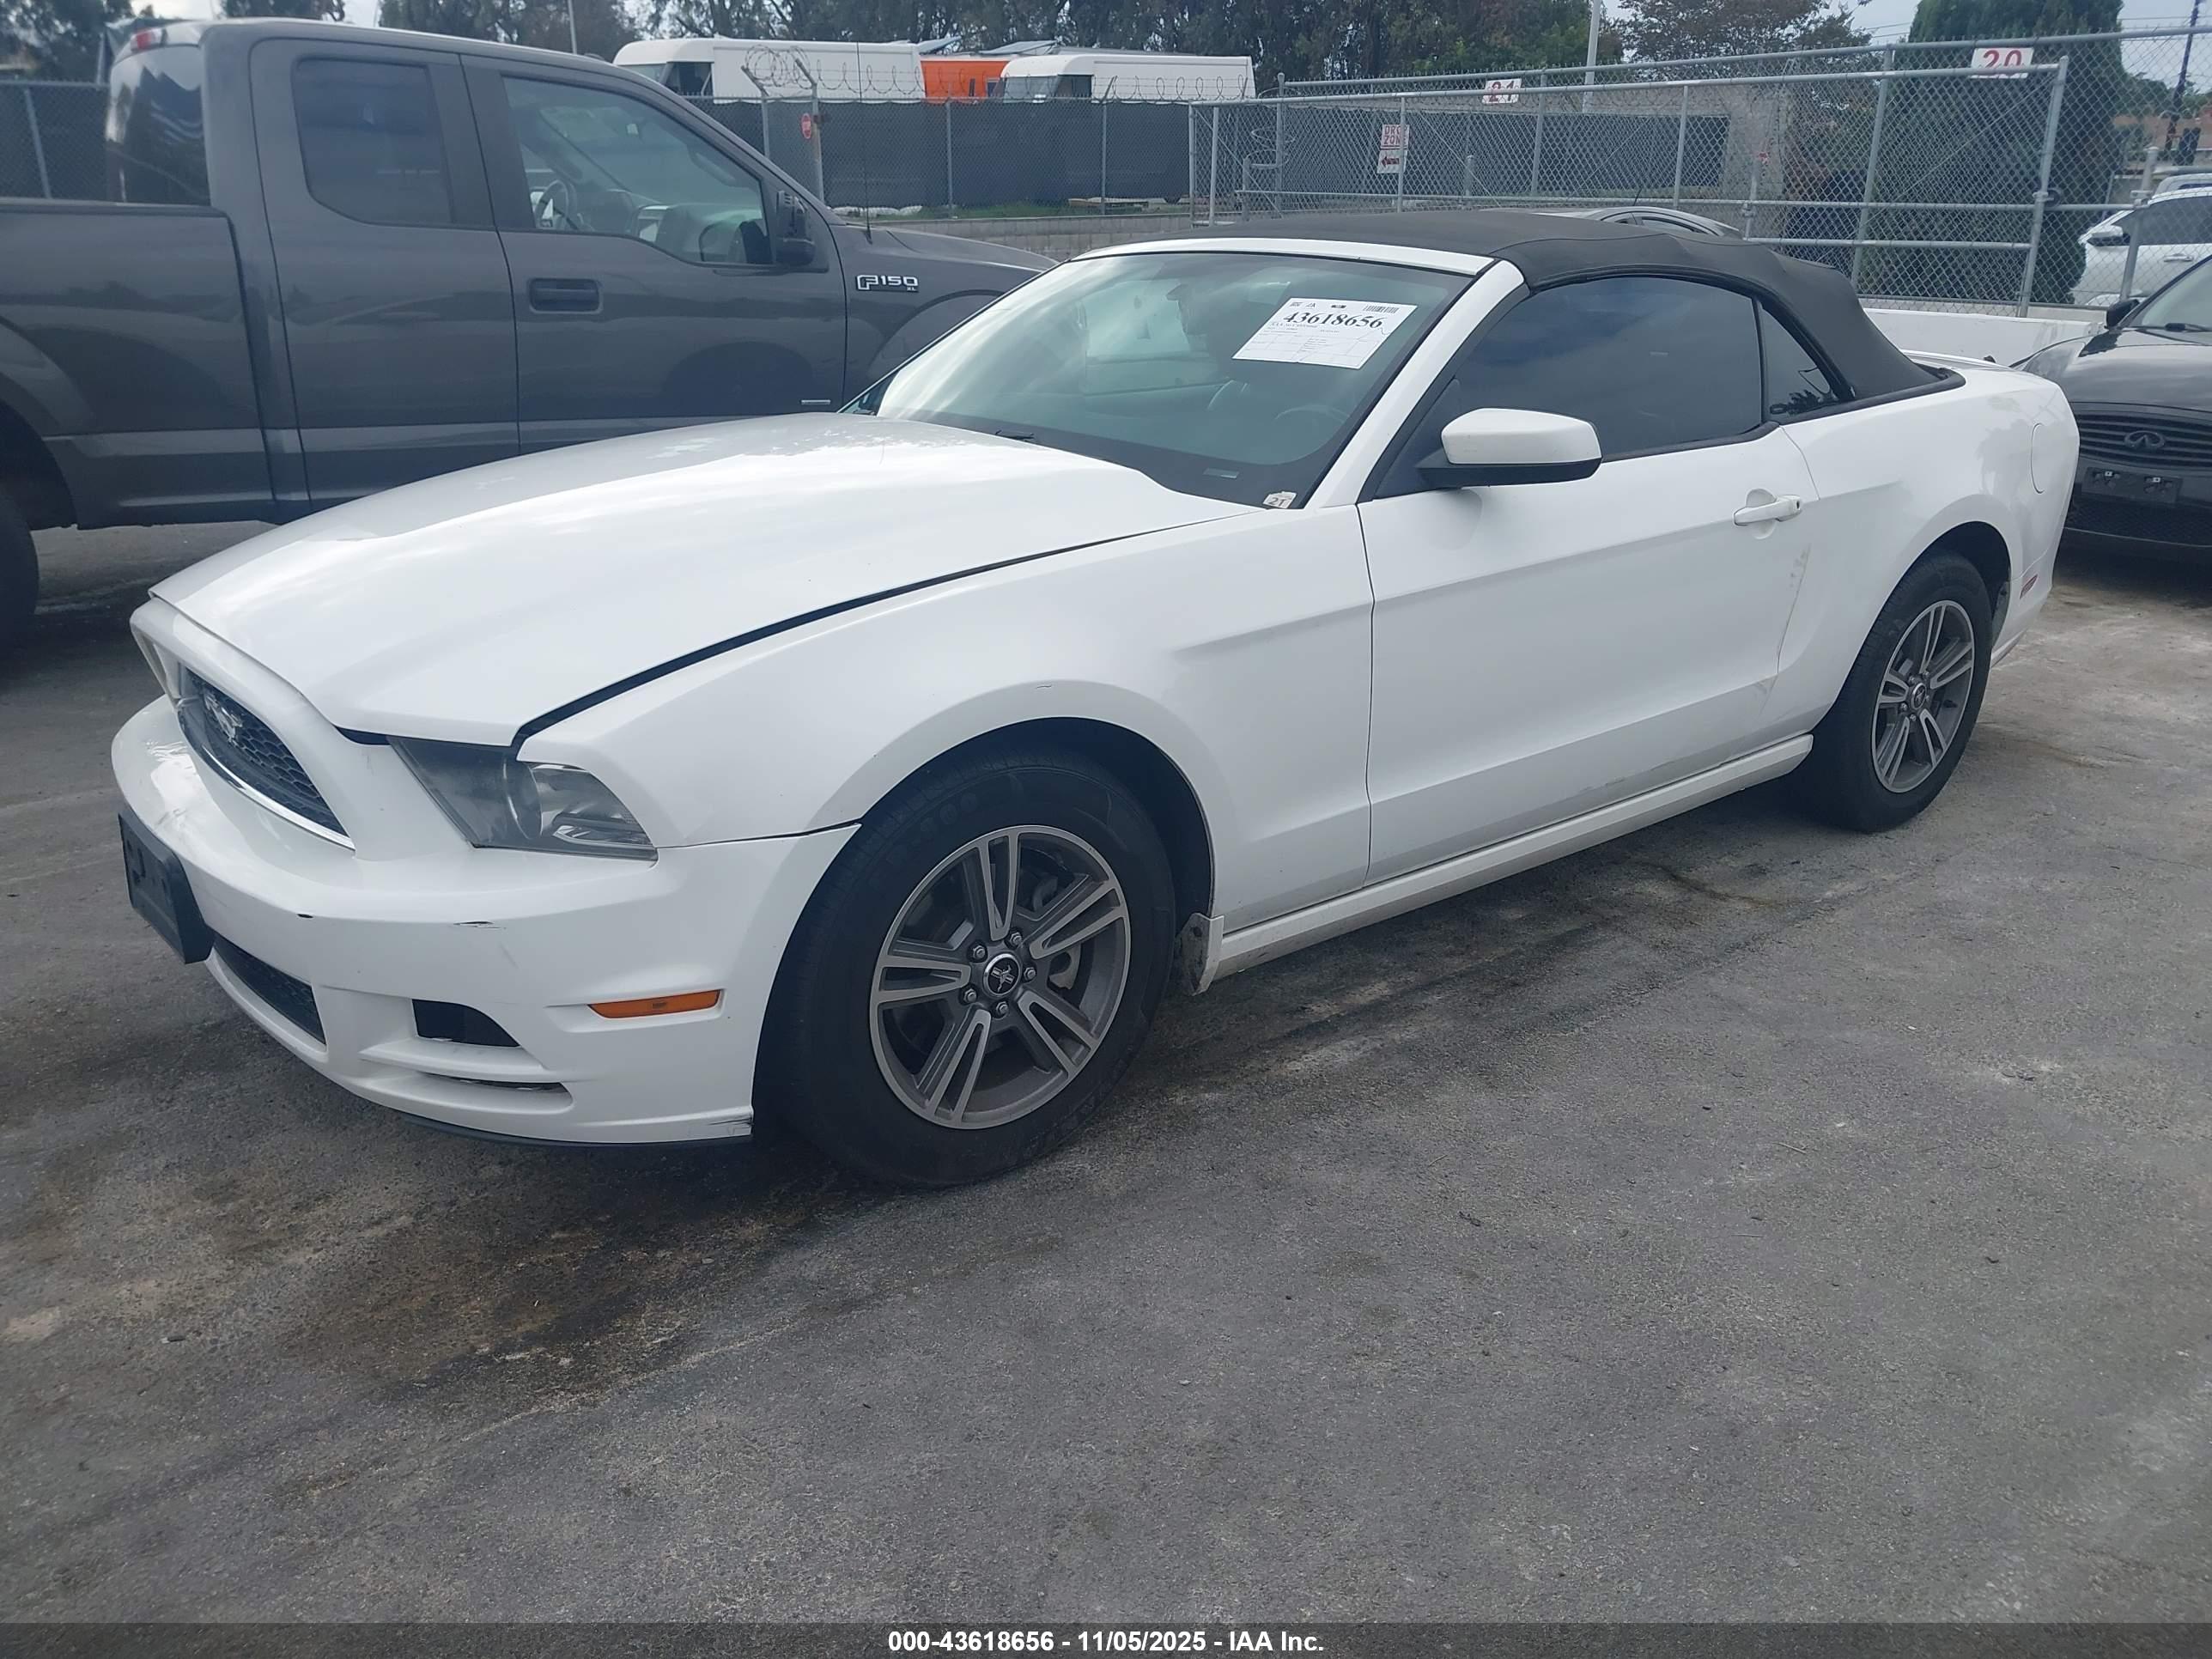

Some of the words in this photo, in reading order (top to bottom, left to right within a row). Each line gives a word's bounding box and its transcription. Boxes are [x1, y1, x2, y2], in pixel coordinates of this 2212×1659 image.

[1983, 49, 2022, 70] 20
[1488, 80, 1515, 102] 21
[1383, 135, 1407, 145] ZON
[1283, 311, 1388, 330] 43618656
